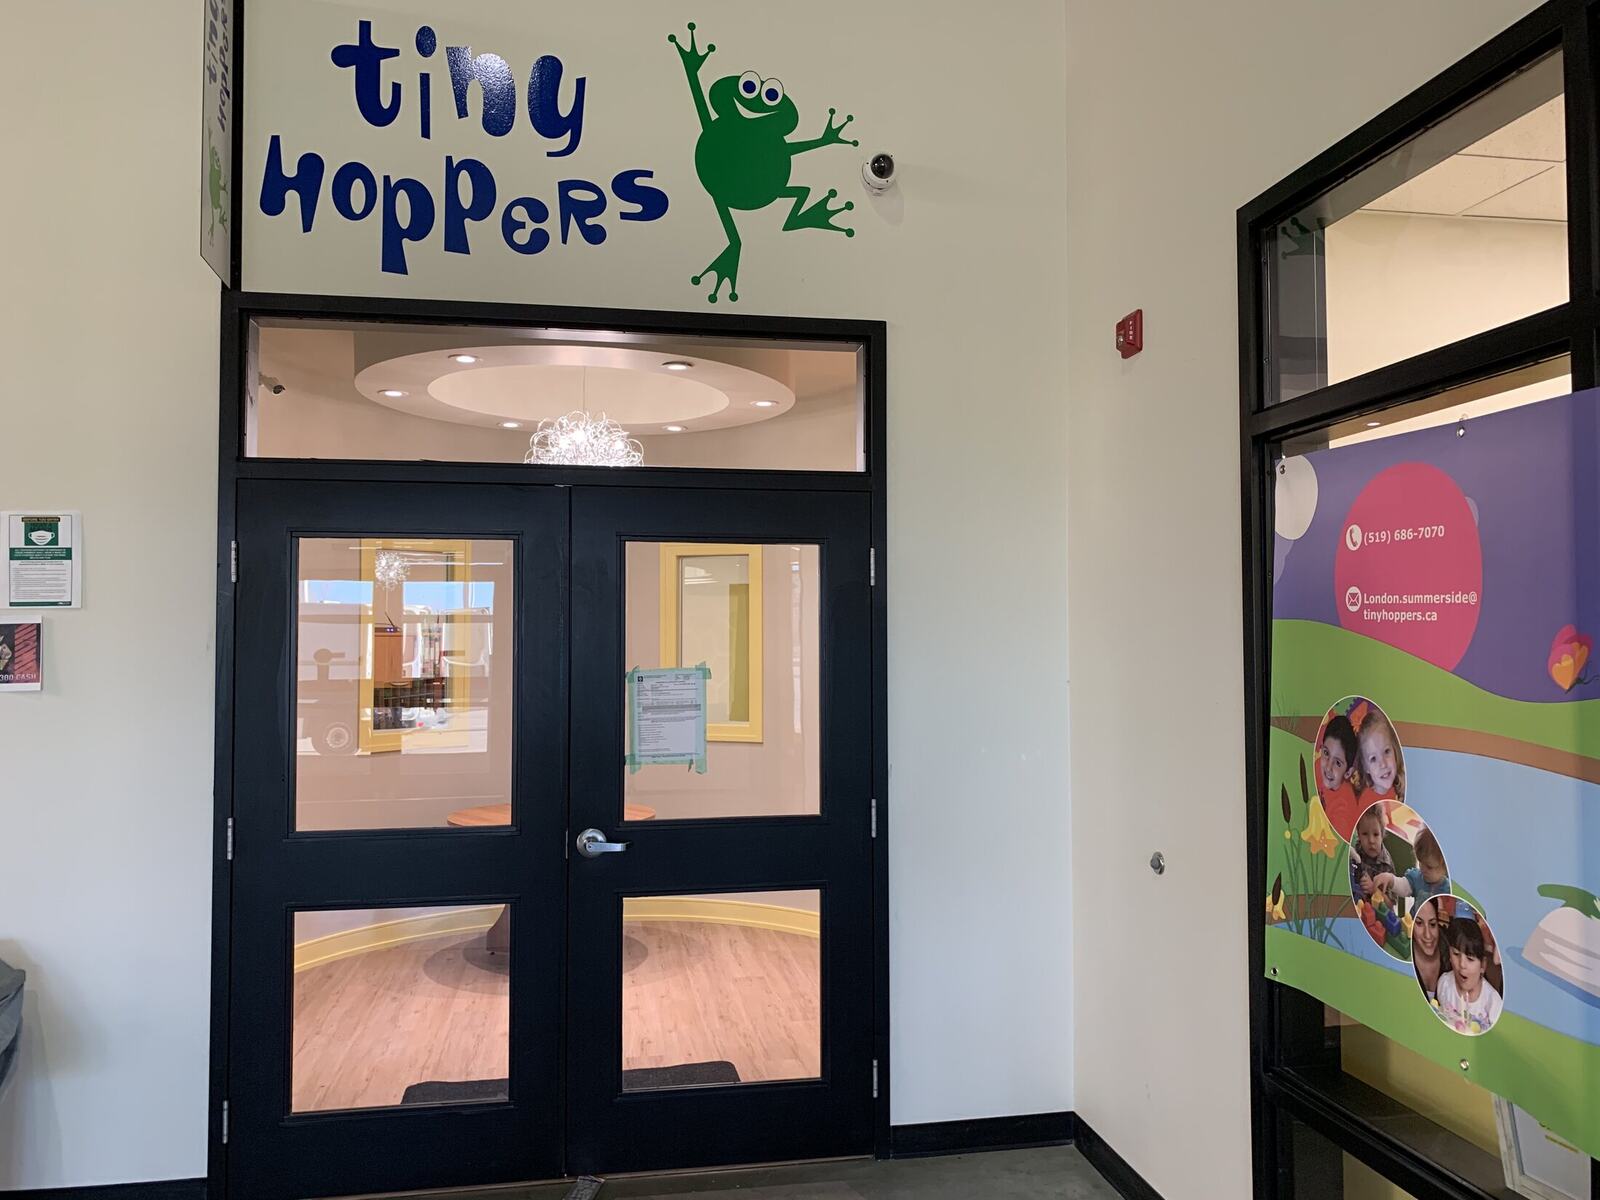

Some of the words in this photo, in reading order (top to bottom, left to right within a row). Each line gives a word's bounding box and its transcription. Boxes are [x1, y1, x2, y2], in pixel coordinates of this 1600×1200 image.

[331, 20, 586, 157] tiny
[259, 135, 669, 275] HOPPERS
[1363, 528, 1391, 546] (519)
[1394, 525, 1446, 542] 686-7070
[1363, 591, 1478, 605] London.summerside@
[1363, 608, 1438, 623] tinyhoppers.ca
